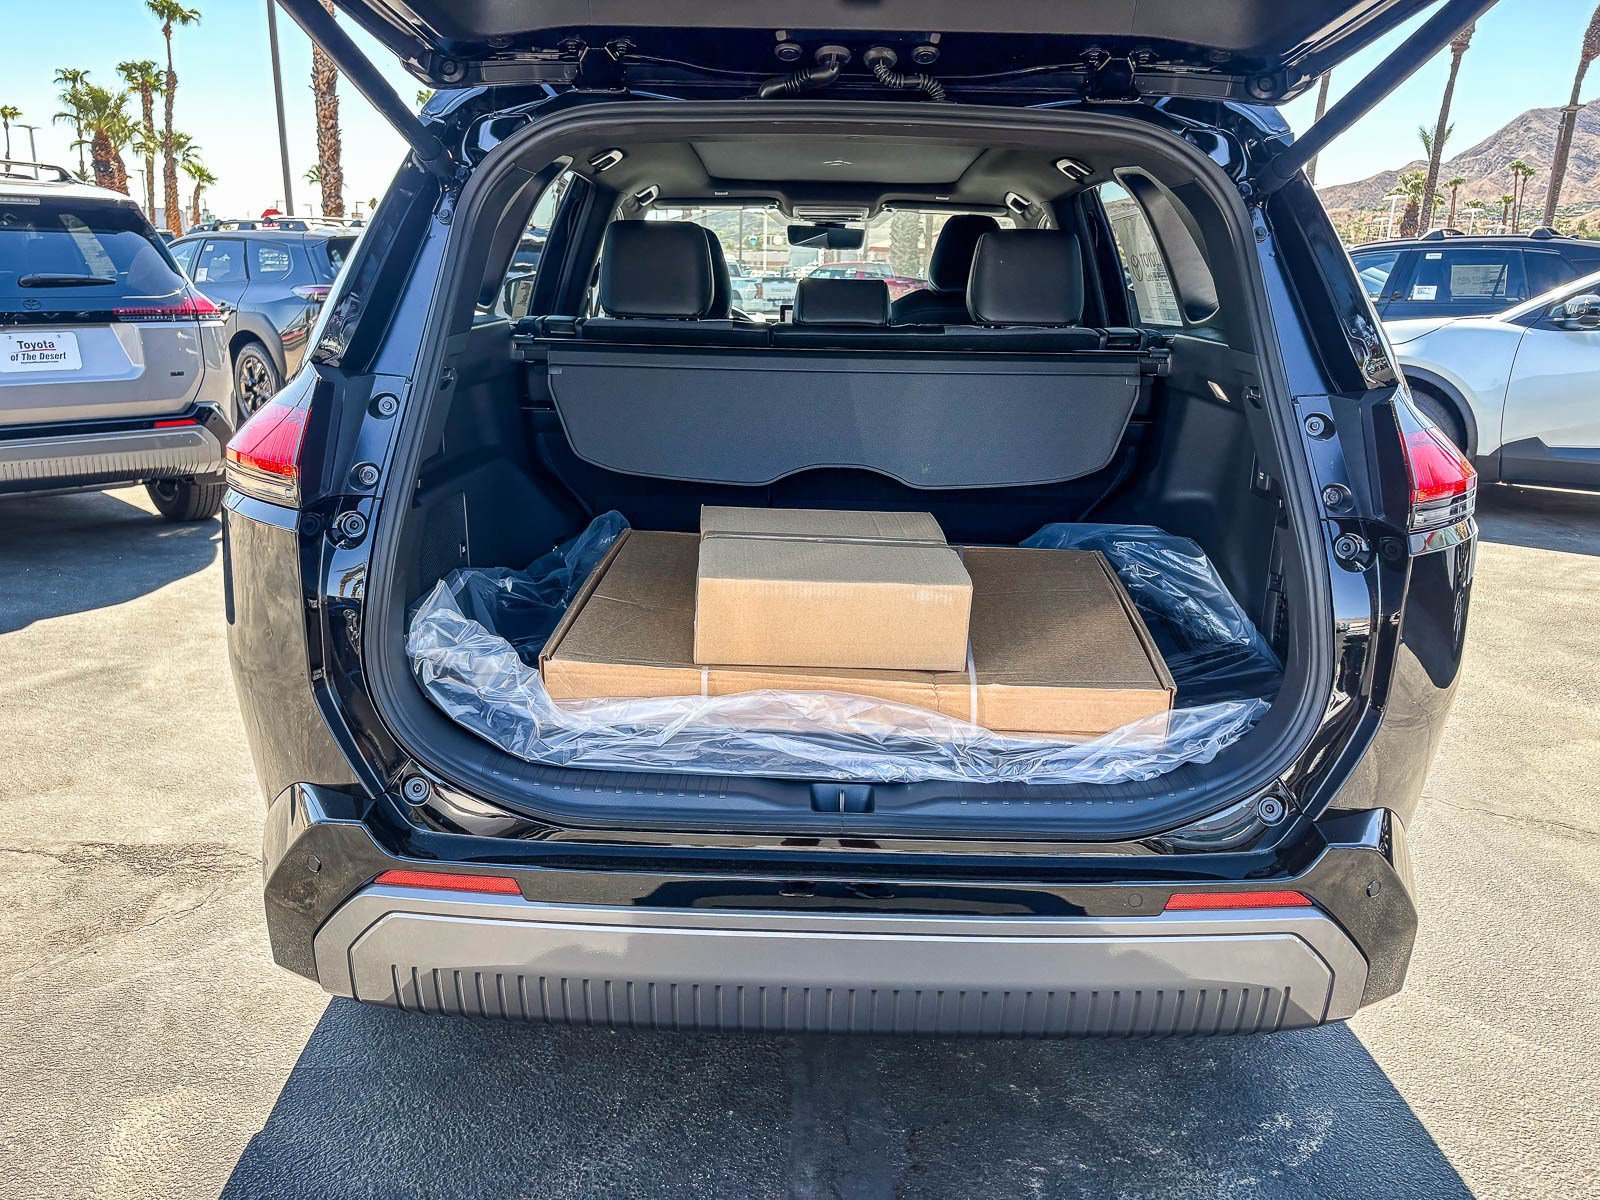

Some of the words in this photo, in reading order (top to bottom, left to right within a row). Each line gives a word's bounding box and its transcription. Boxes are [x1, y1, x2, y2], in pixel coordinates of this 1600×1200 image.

[16, 340, 55, 351] Toyota
[10, 353, 19, 362] of
[21, 352, 37, 361] The
[39, 351, 67, 361] Desert
